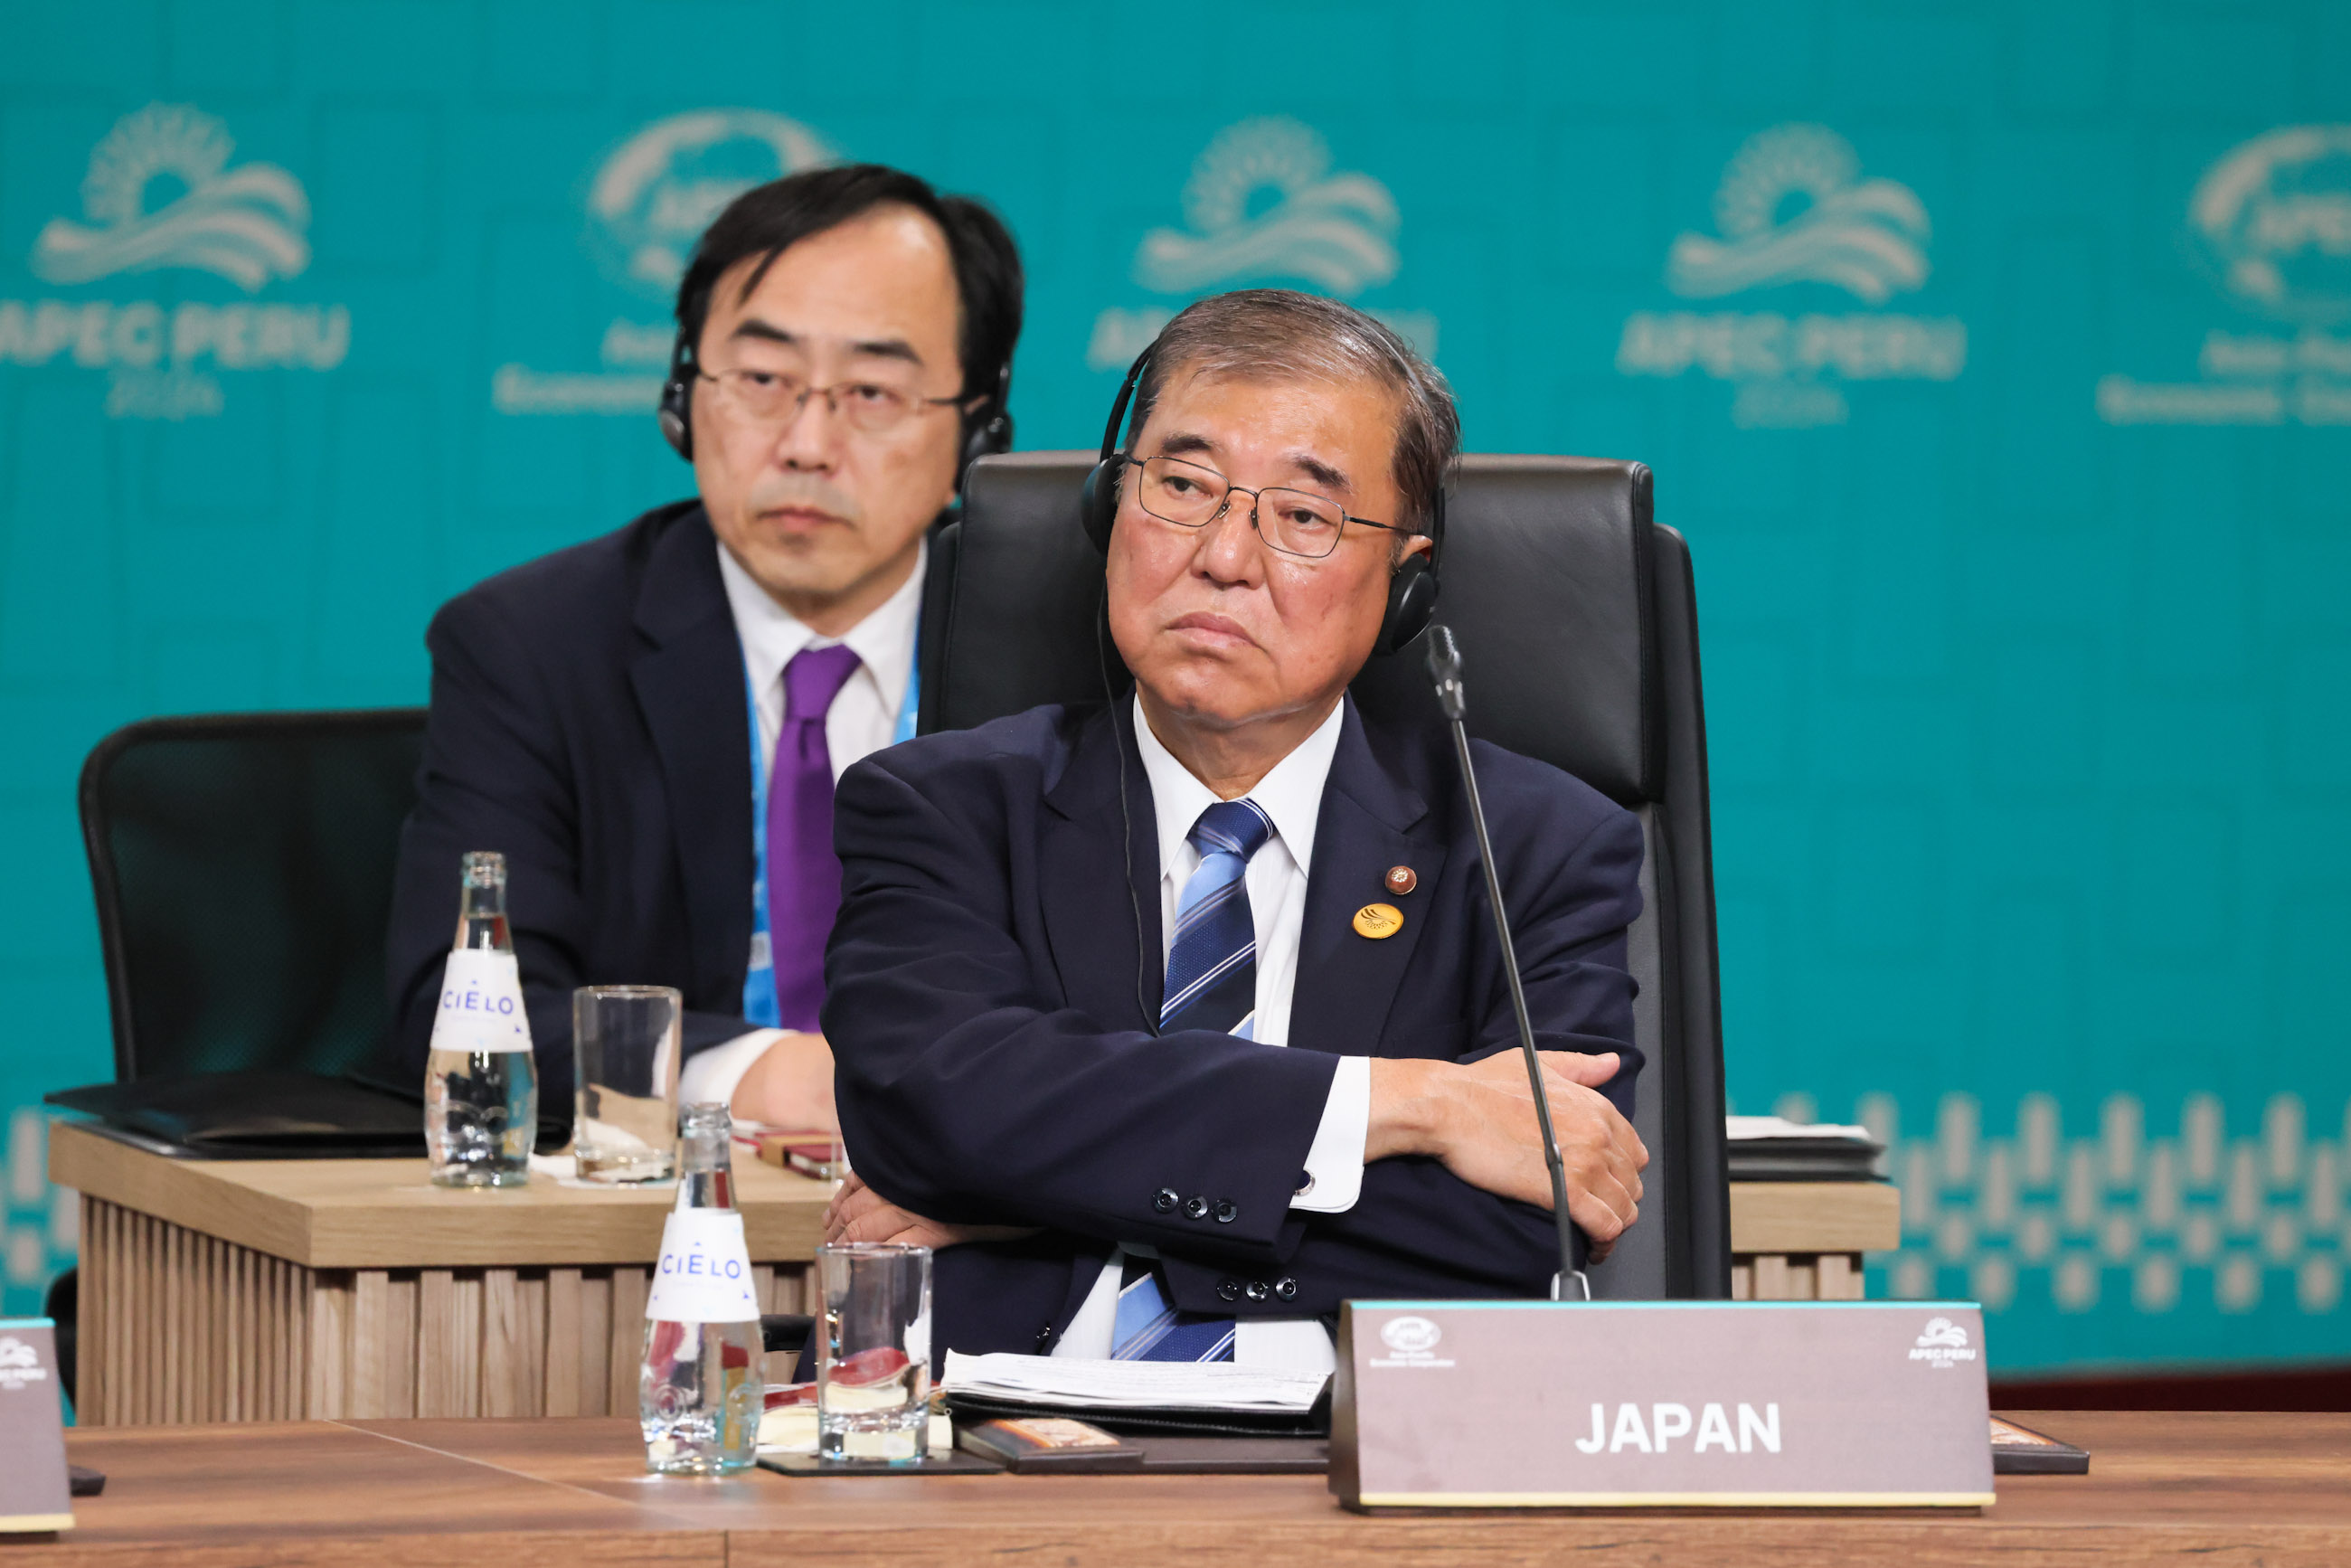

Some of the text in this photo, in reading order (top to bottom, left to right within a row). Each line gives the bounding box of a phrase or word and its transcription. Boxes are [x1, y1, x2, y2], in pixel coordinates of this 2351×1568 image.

[174, 302, 351, 370] PERU
[1617, 311, 1967, 381] APEC PERU
[443, 991, 514, 1015] CIELO
[662, 1254, 741, 1279] CIELO
[1908, 1348, 1977, 1361] APEC PERU
[1575, 1403, 1781, 1453] JAPAN
